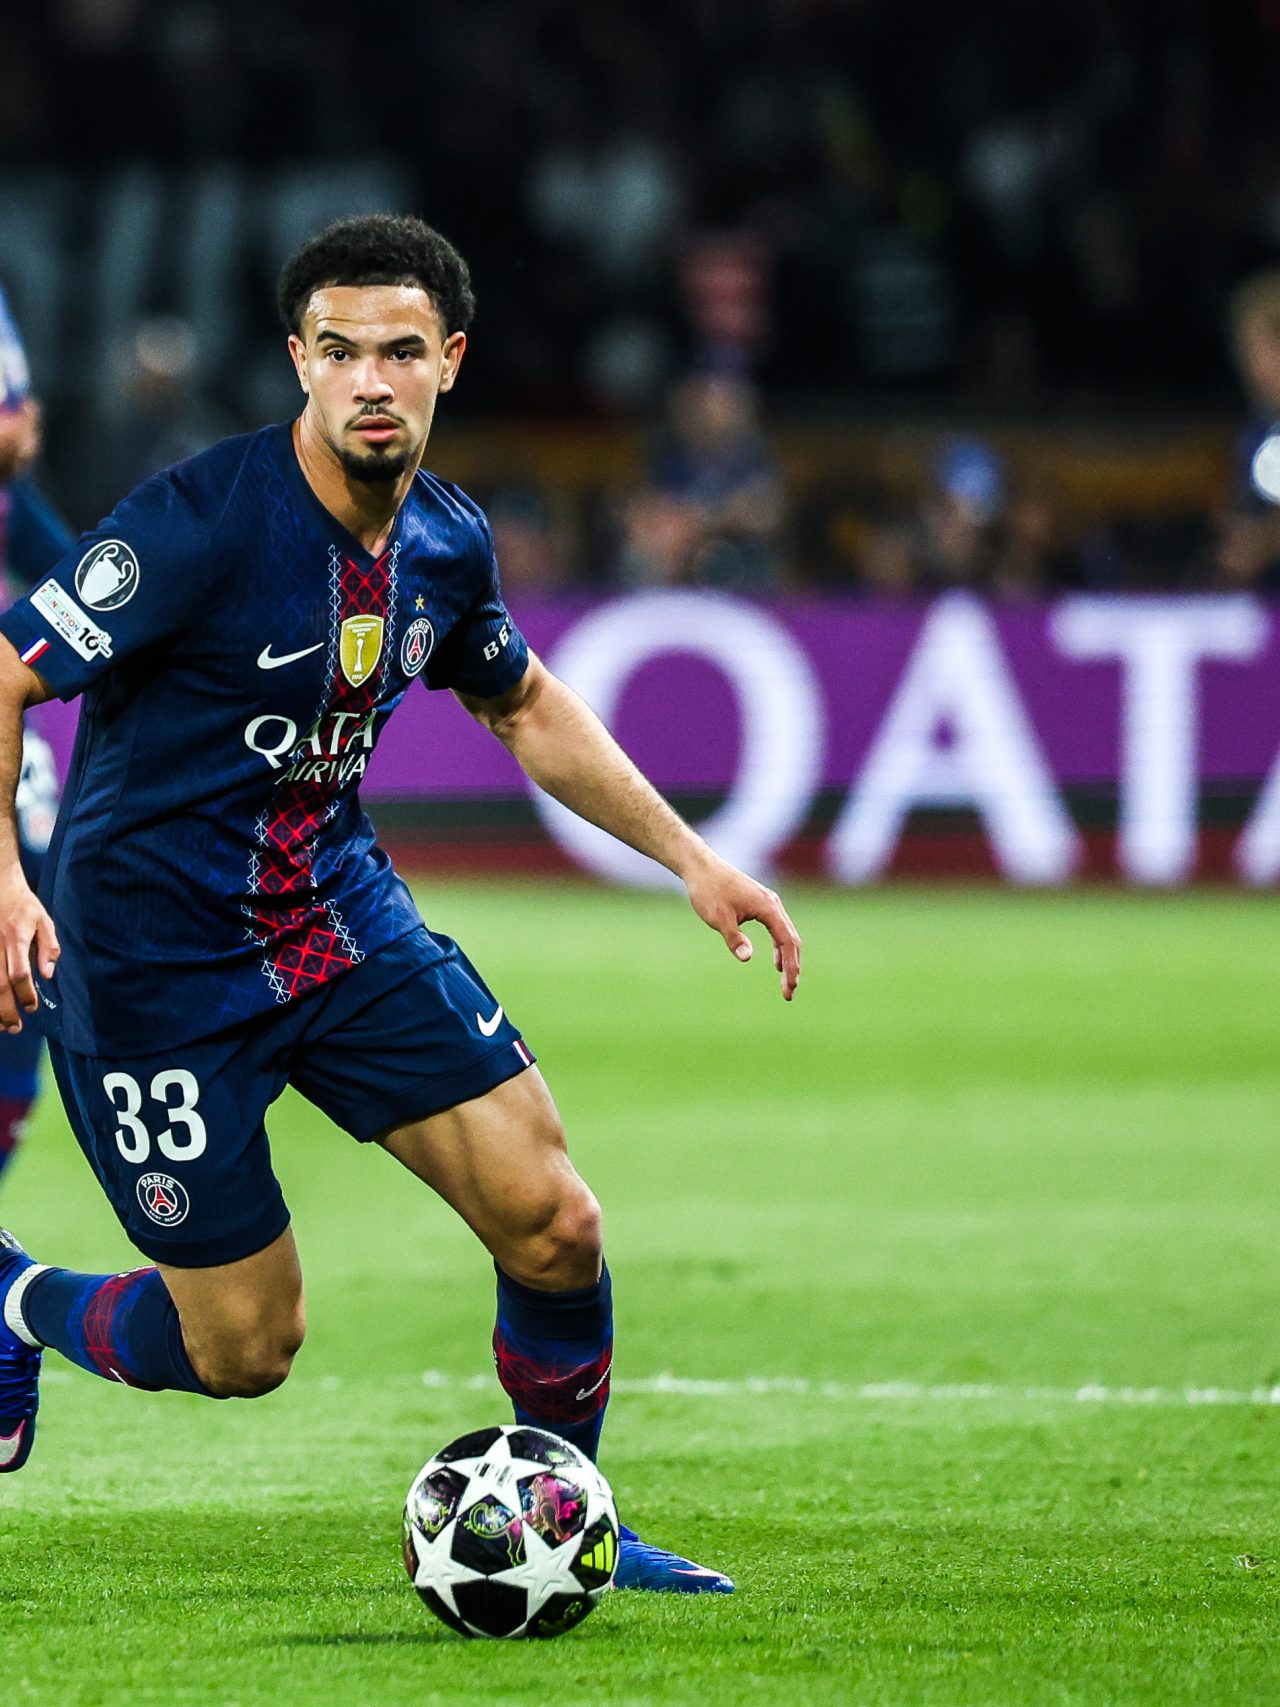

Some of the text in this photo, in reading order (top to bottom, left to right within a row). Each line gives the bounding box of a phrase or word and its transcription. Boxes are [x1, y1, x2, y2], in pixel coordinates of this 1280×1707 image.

[408, 620, 430, 636] PARIS
[244, 711, 377, 769] QATA
[526, 588, 1280, 888] QAT
[274, 753, 367, 785] AIRWA
[103, 1069, 207, 1164] 33
[141, 1175, 174, 1189] PARIS
